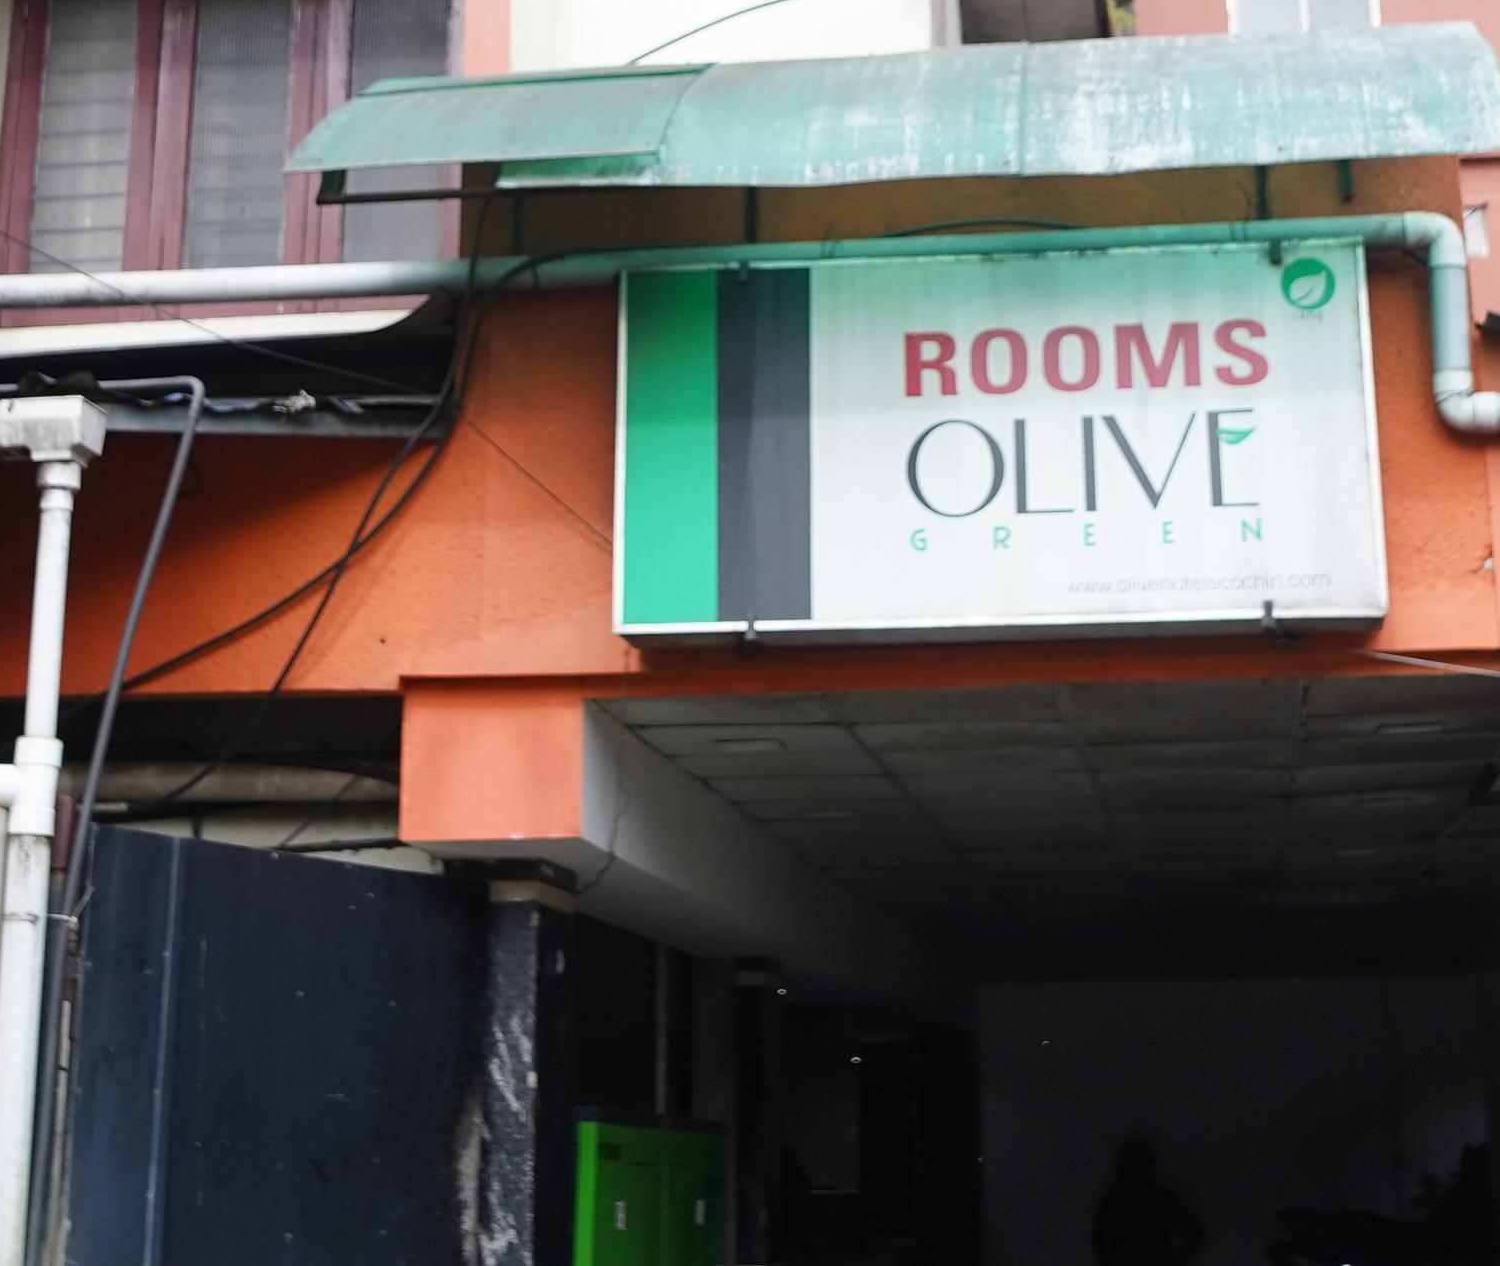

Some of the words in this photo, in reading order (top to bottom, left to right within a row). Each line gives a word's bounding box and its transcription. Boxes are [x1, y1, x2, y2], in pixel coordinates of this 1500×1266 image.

[904, 319, 1269, 397] ROOMS
[906, 408, 1261, 517] OLIVE
[910, 518, 1264, 551] GREEN
